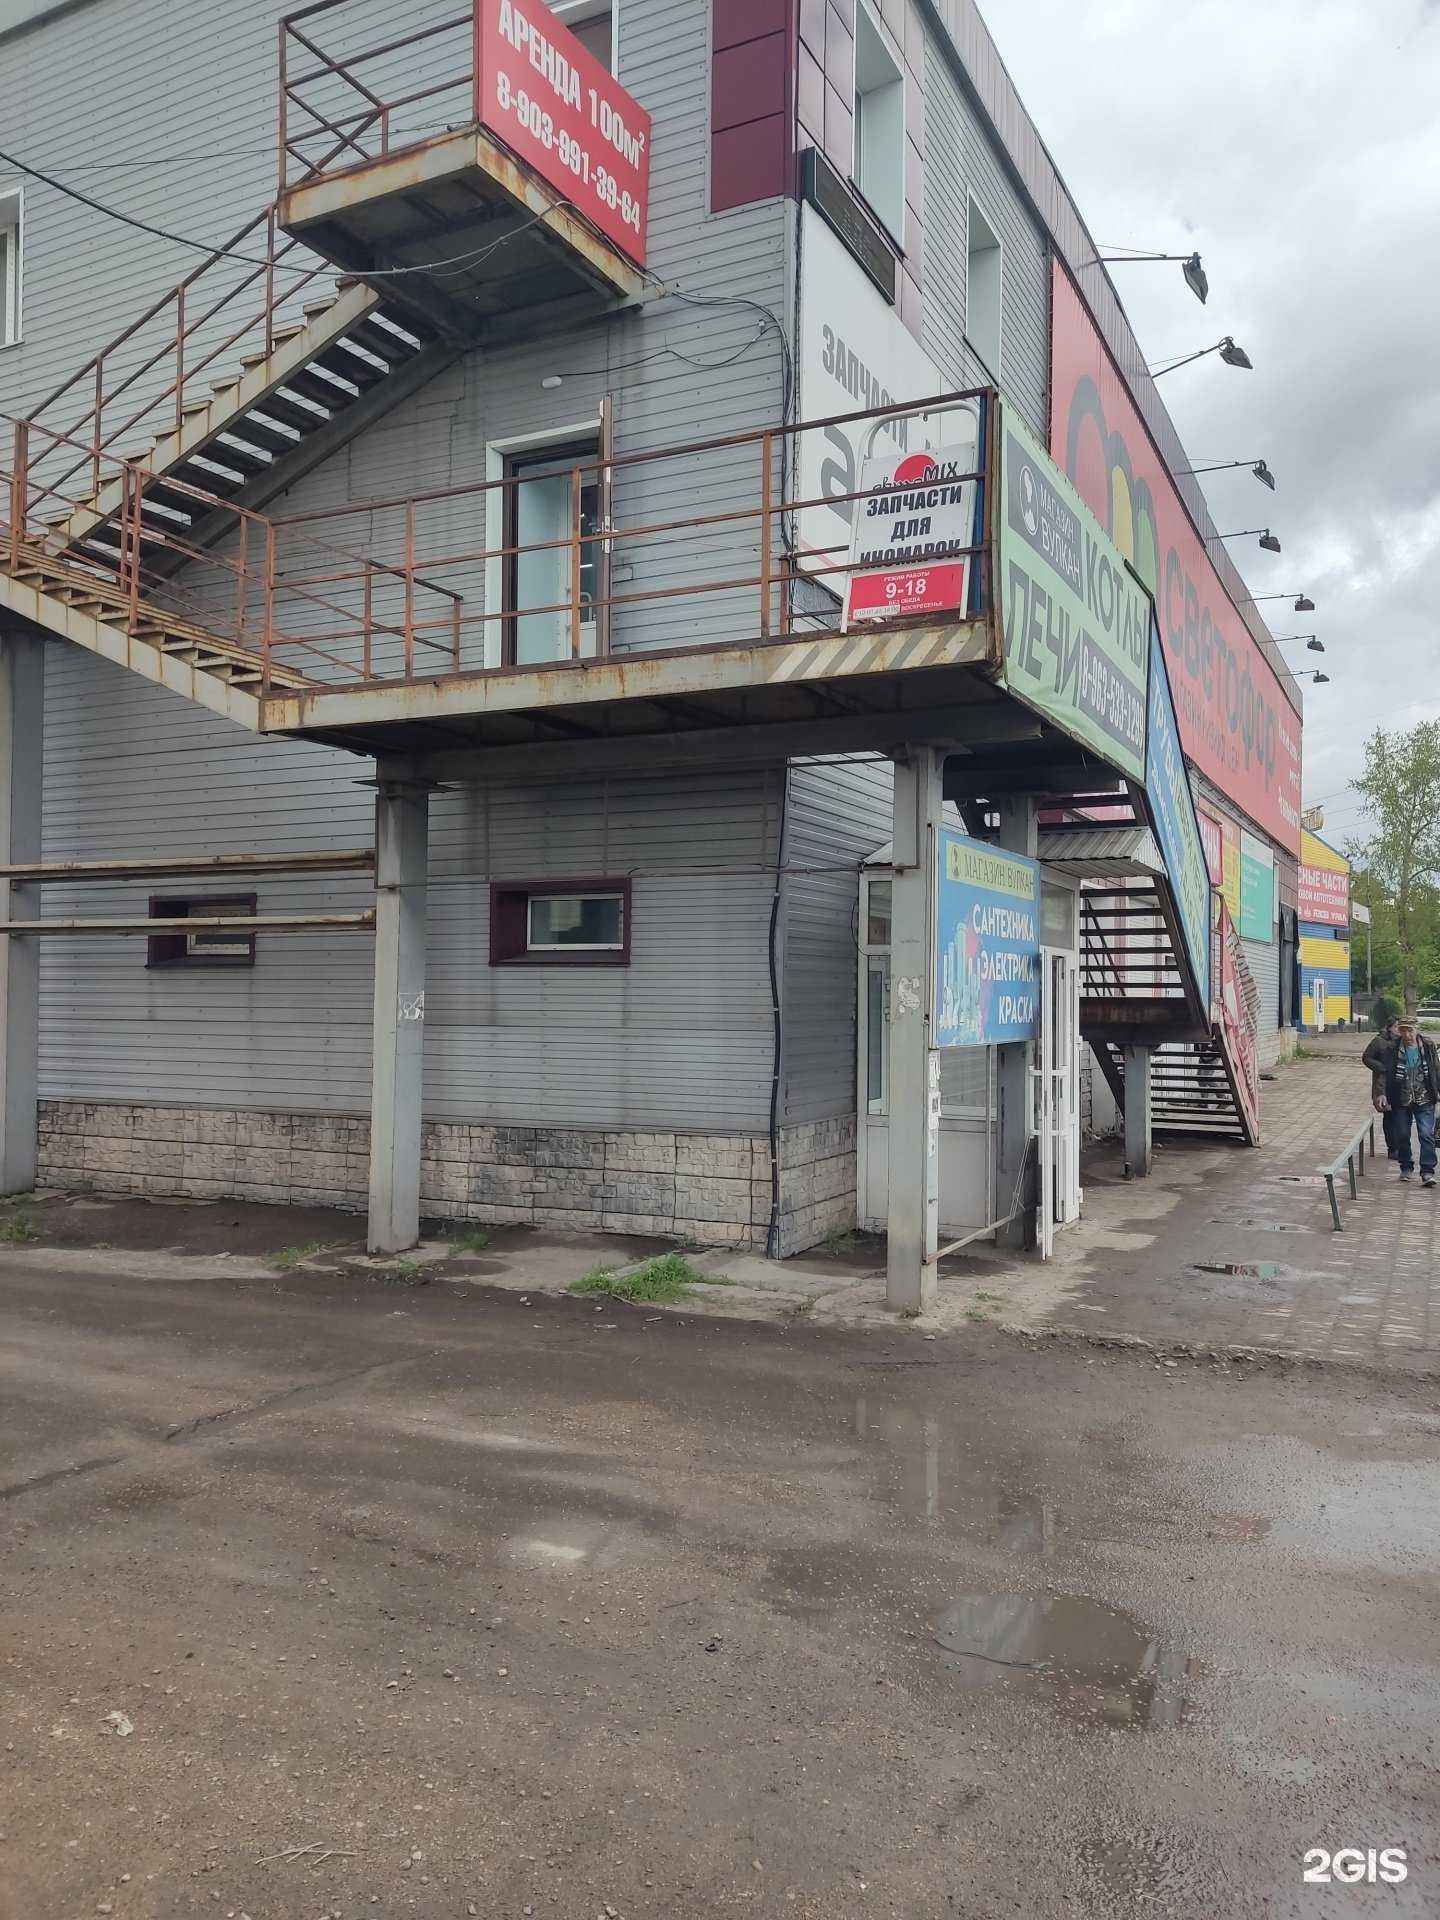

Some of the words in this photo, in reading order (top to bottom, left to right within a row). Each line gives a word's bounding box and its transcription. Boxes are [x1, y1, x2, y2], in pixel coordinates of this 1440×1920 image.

[498, 0, 582, 112] АРЕНДА
[496, 70, 641, 234] 8-903-991-39-64
[866, 485, 963, 517] ЗАПЧАСТИ
[1039, 482, 1075, 543] МАГАЗИН
[890, 516, 932, 543] ДЛЯ
[1041, 515, 1081, 588] ВУЛКАН
[885, 578, 927, 599] 9-18
[905, 571, 930, 580] РАБОТЫ
[1085, 529, 1148, 676] КОТЛЫ
[1004, 559, 1082, 708] ПЕЧИ
[981, 950, 1035, 982] ЭЛЕКТРИКА
[998, 995, 1034, 1025] КРАСКА
